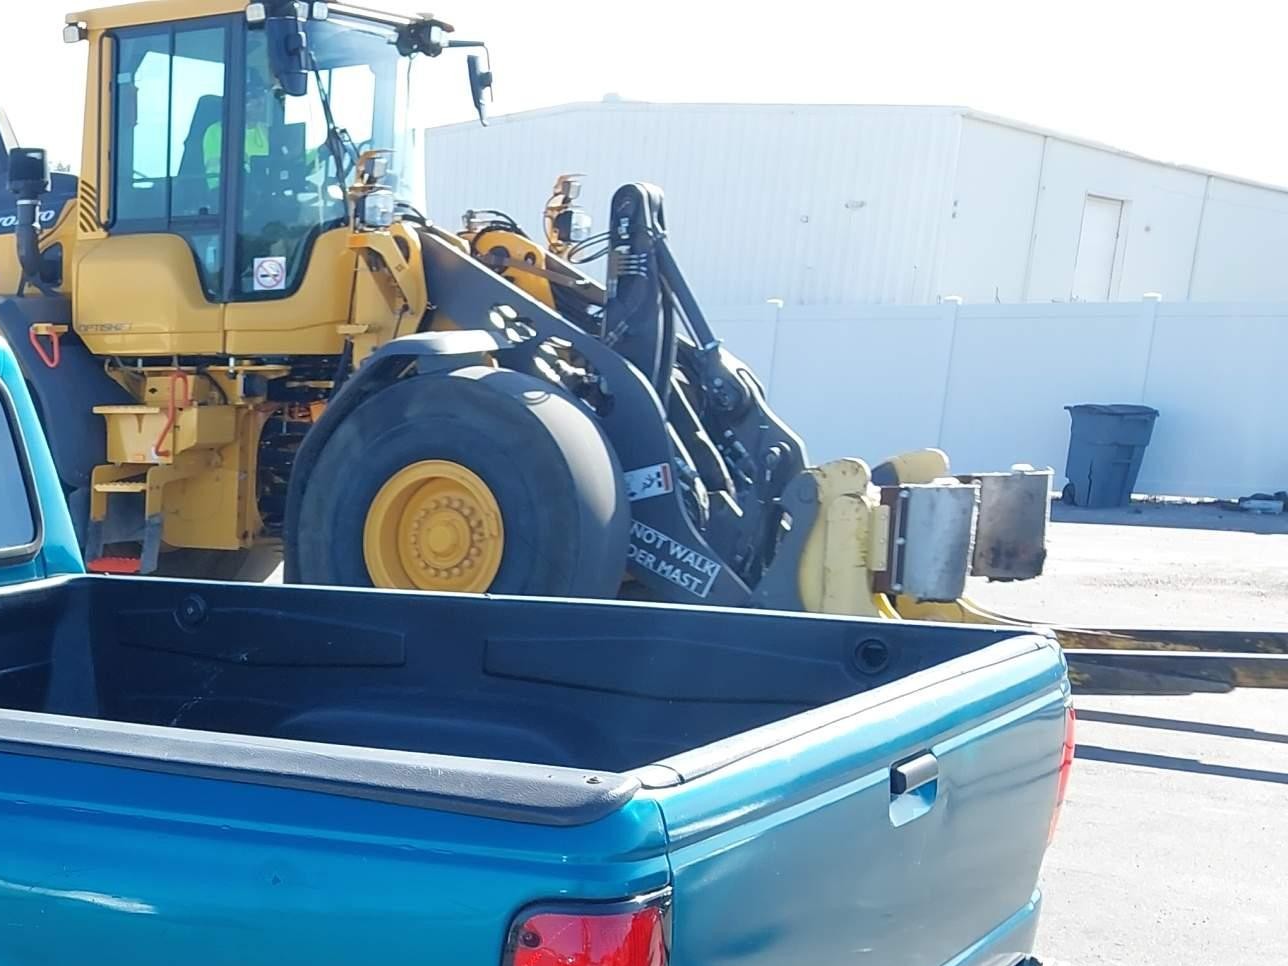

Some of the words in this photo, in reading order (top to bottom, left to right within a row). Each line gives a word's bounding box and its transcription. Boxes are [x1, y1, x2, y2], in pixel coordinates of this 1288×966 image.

[629, 523, 667, 549] NOT
[669, 543, 716, 577] WALK
[657, 561, 704, 593] MAST
